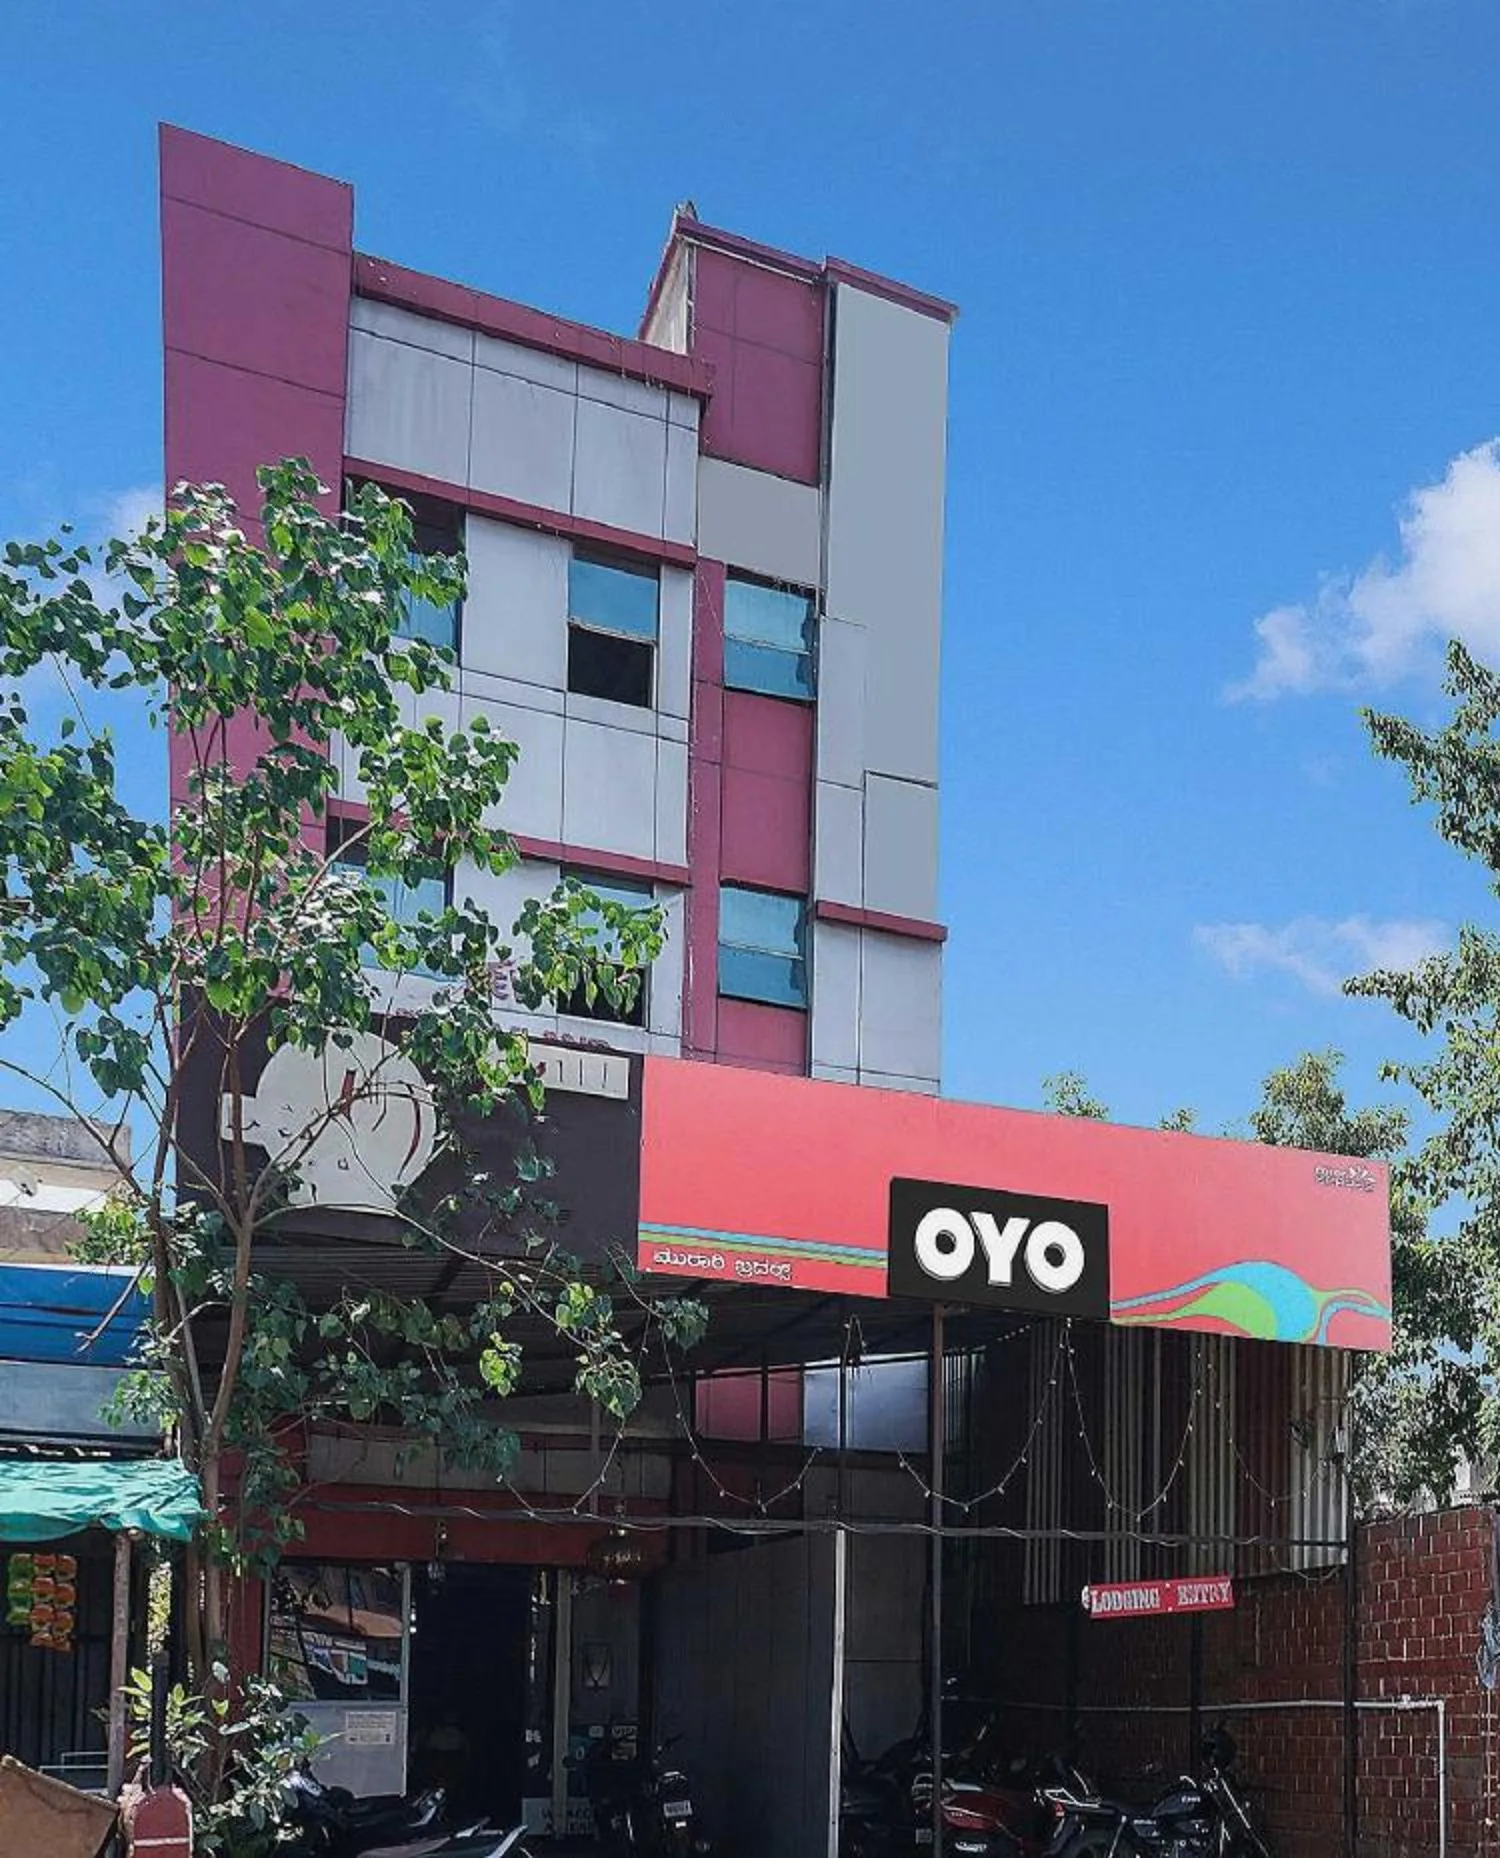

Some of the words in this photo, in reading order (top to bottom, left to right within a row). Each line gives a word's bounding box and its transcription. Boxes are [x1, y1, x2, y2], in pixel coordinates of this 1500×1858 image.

[914, 1207, 1085, 1294] OYO
[1090, 1587, 1161, 1614] LODGING
[1177, 1580, 1232, 1606] ENTRY
